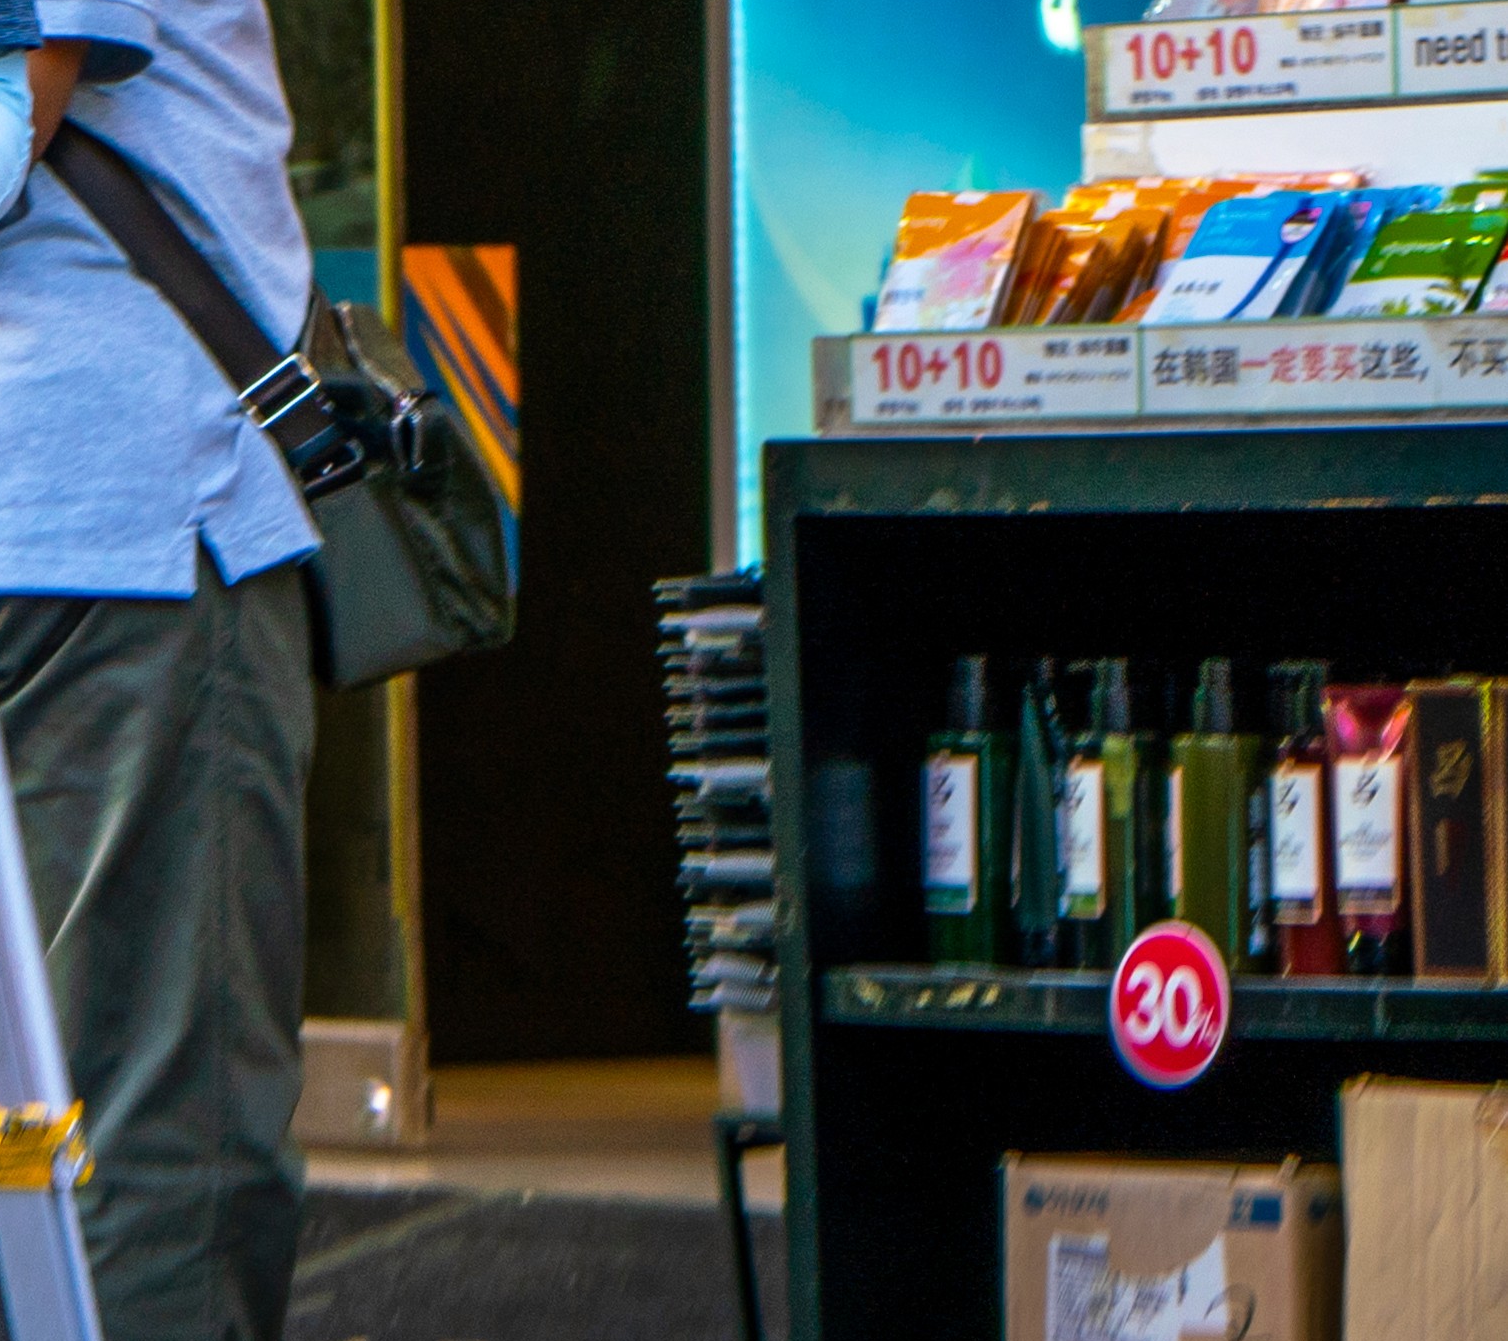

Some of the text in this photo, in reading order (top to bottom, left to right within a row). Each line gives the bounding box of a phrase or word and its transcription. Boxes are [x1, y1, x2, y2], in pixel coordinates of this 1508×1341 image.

[1127, 26, 1258, 82] 10+10
[1415, 27, 1487, 68] need
[872, 339, 1005, 393] 10+10
[1123, 961, 1220, 1049] 30%
